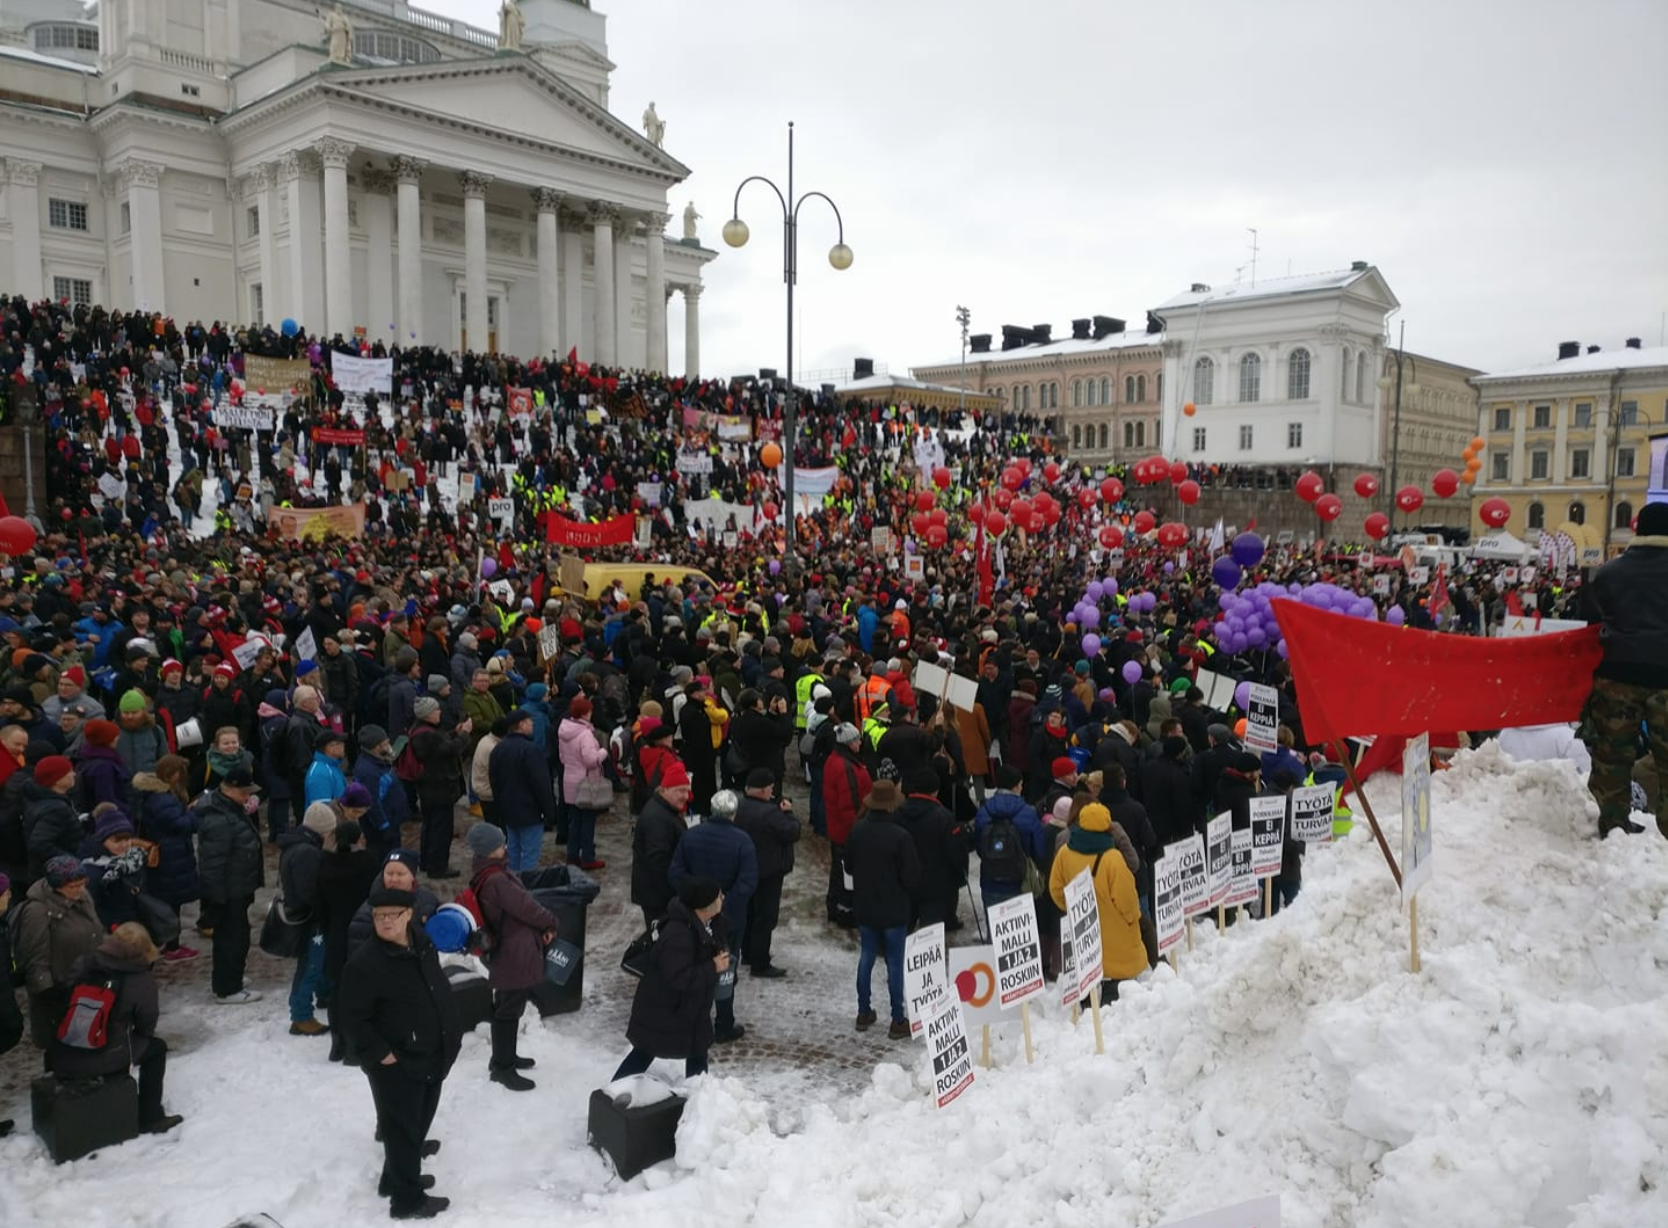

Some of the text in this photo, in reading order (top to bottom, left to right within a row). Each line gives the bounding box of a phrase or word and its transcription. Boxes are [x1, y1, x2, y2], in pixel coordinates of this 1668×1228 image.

[492, 502, 511, 514] pro
[1480, 539, 1499, 549] pro
[1583, 549, 1599, 558] pro
[1250, 711, 1274, 726] KEPPIÄ
[1295, 793, 1332, 811] TYÖTÄ
[1266, 820, 1273, 831] EI
[1295, 815, 1332, 830] TURVAA
[1255, 829, 1280, 846] KEPPIÄ
[1235, 851, 1243, 863] EI
[1232, 862, 1252, 877] EPPIÄ
[1183, 875, 1206, 892] RVAA
[995, 912, 1033, 937] AKTIIVI-
[1001, 929, 1031, 952] MALLI
[907, 943, 942, 972] LEIPÄÄ
[1005, 947, 1032, 970] 1 JA 2
[1063, 956, 1075, 972] KE
[921, 971, 933, 989] JA
[1000, 963, 1040, 991] ROSKIIN
[928, 1006, 959, 1038] AKTIIVI-
[935, 1023, 960, 1053] MALLI
[940, 1041, 964, 1070] 1 JA 2
[937, 1057, 971, 1094] ROSKIIN
